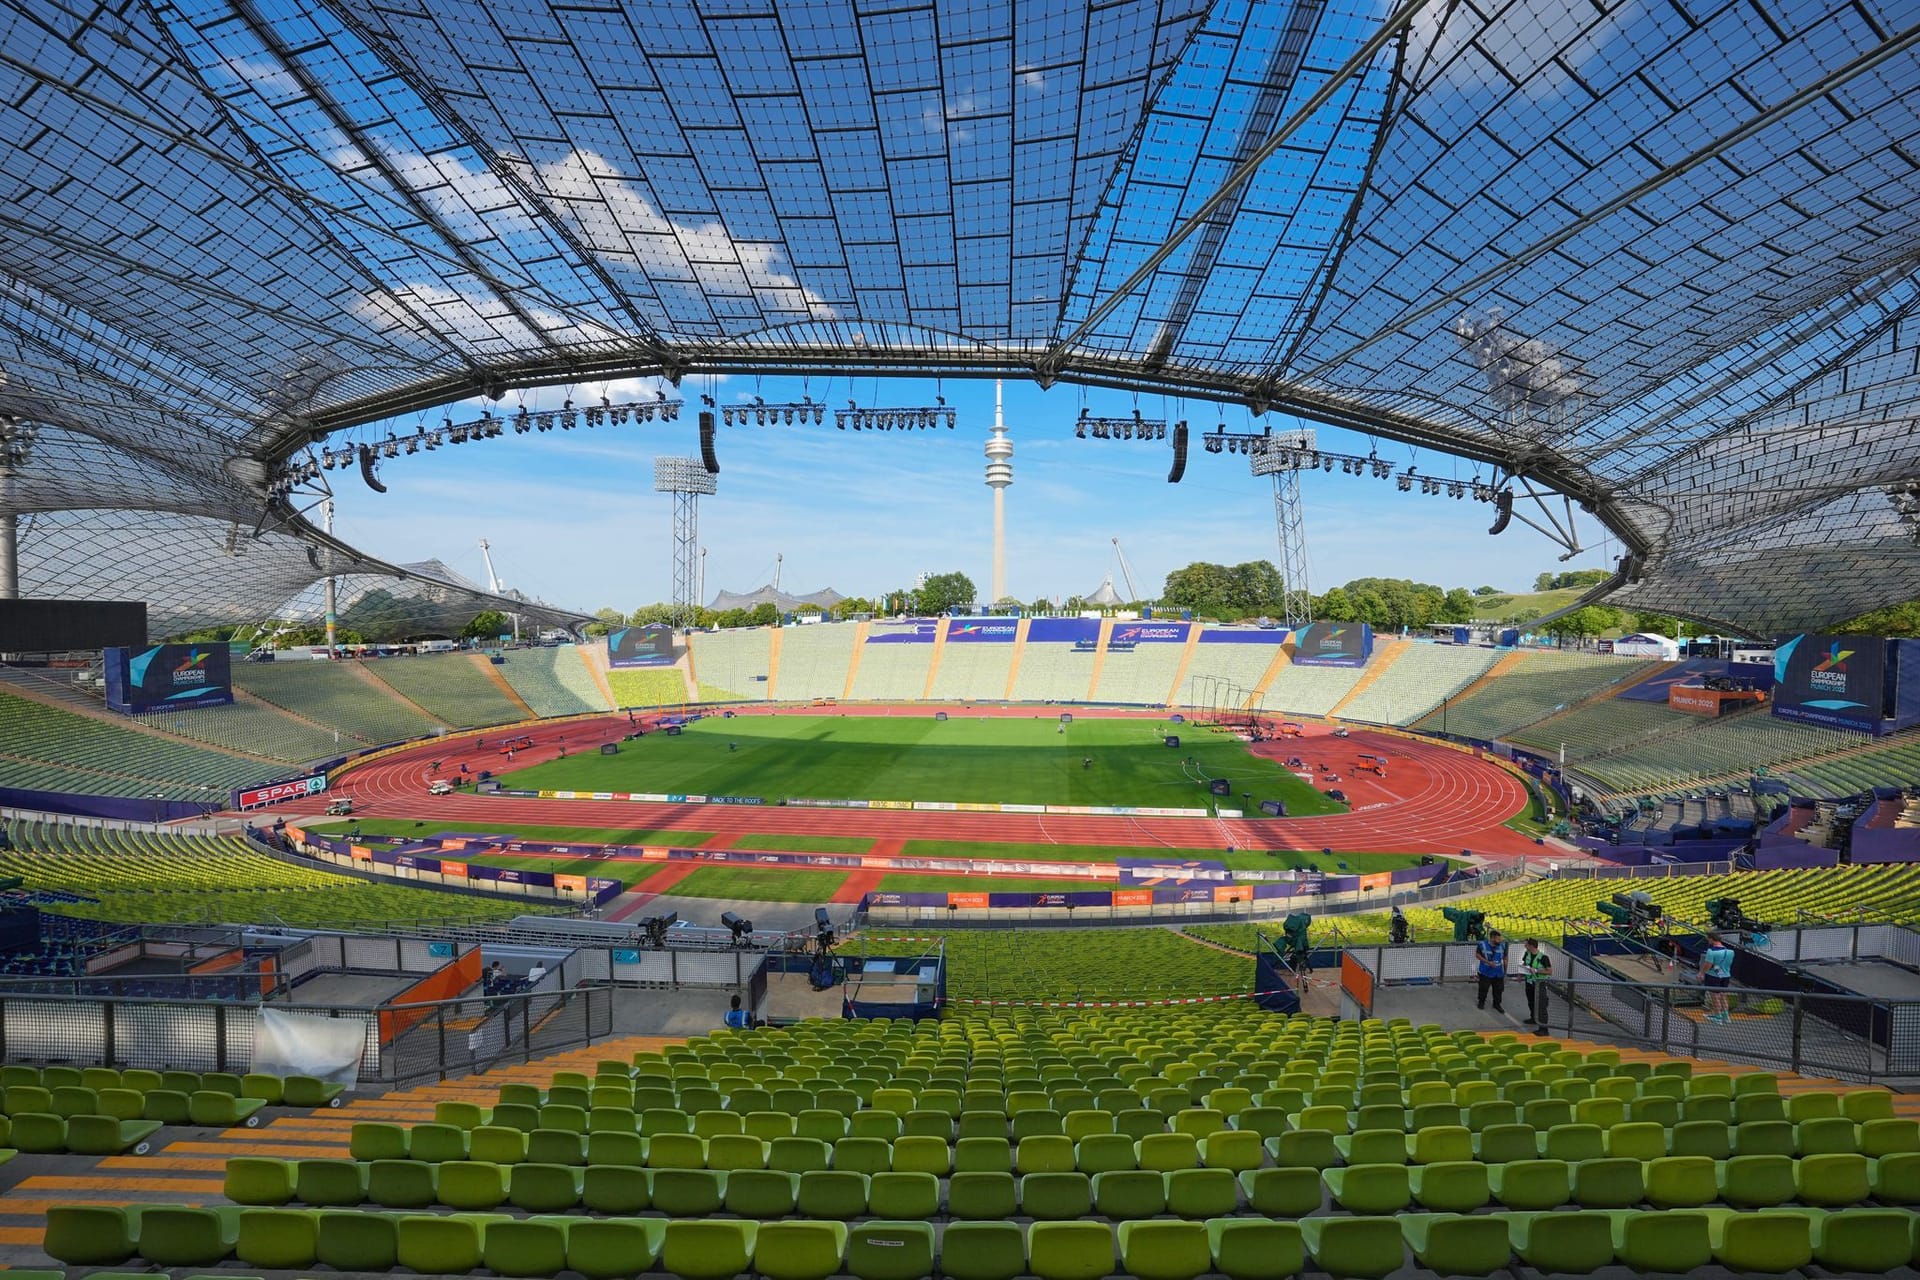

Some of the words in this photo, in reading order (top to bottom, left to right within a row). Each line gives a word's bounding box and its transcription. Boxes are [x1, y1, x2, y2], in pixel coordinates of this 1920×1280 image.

[1810, 671, 1846, 681] EUROPEAN
[1810, 678, 1846, 687] CHAMPIONSHIPS
[1673, 696, 1697, 705] MUNICH
[1838, 718, 1858, 726] MUNICH
[1858, 721, 1872, 729] 2022
[258, 784, 306, 800] SPAR
[441, 946, 447, 955] Z
[616, 952, 622, 960] Z
